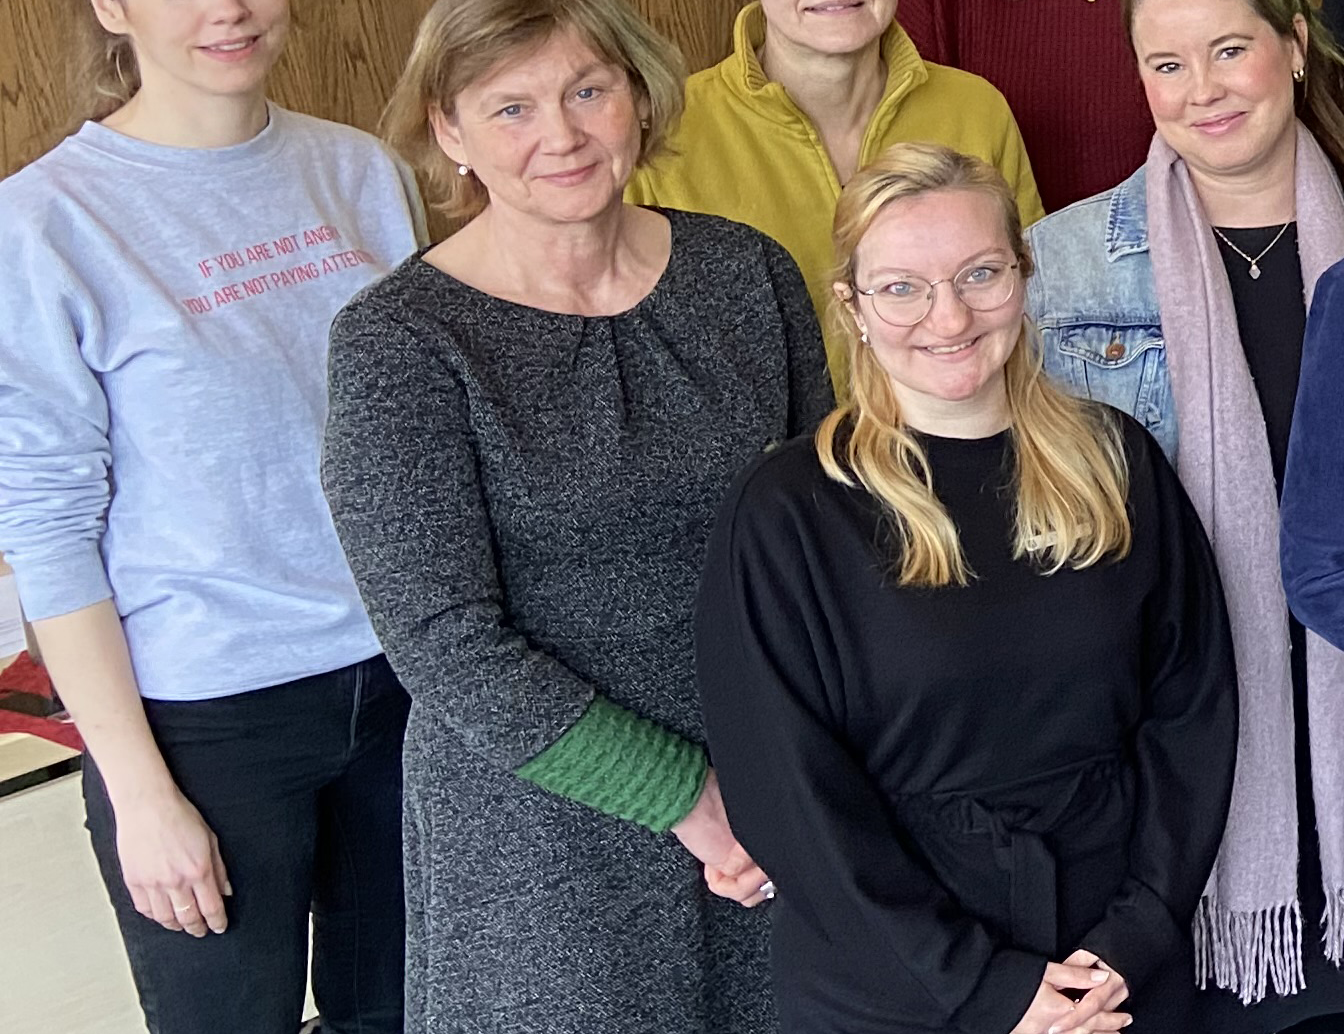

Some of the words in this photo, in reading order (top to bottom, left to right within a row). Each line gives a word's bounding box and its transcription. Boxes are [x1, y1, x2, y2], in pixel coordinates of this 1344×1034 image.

[198, 259, 213, 279] IF
[215, 251, 245, 272] YOU
[246, 242, 274, 263] ARE
[273, 234, 301, 256] NOT
[182, 295, 212, 315] YOU
[214, 284, 244, 307] ARE
[242, 275, 271, 298] NOT
[270, 262, 320, 289] PAYING
